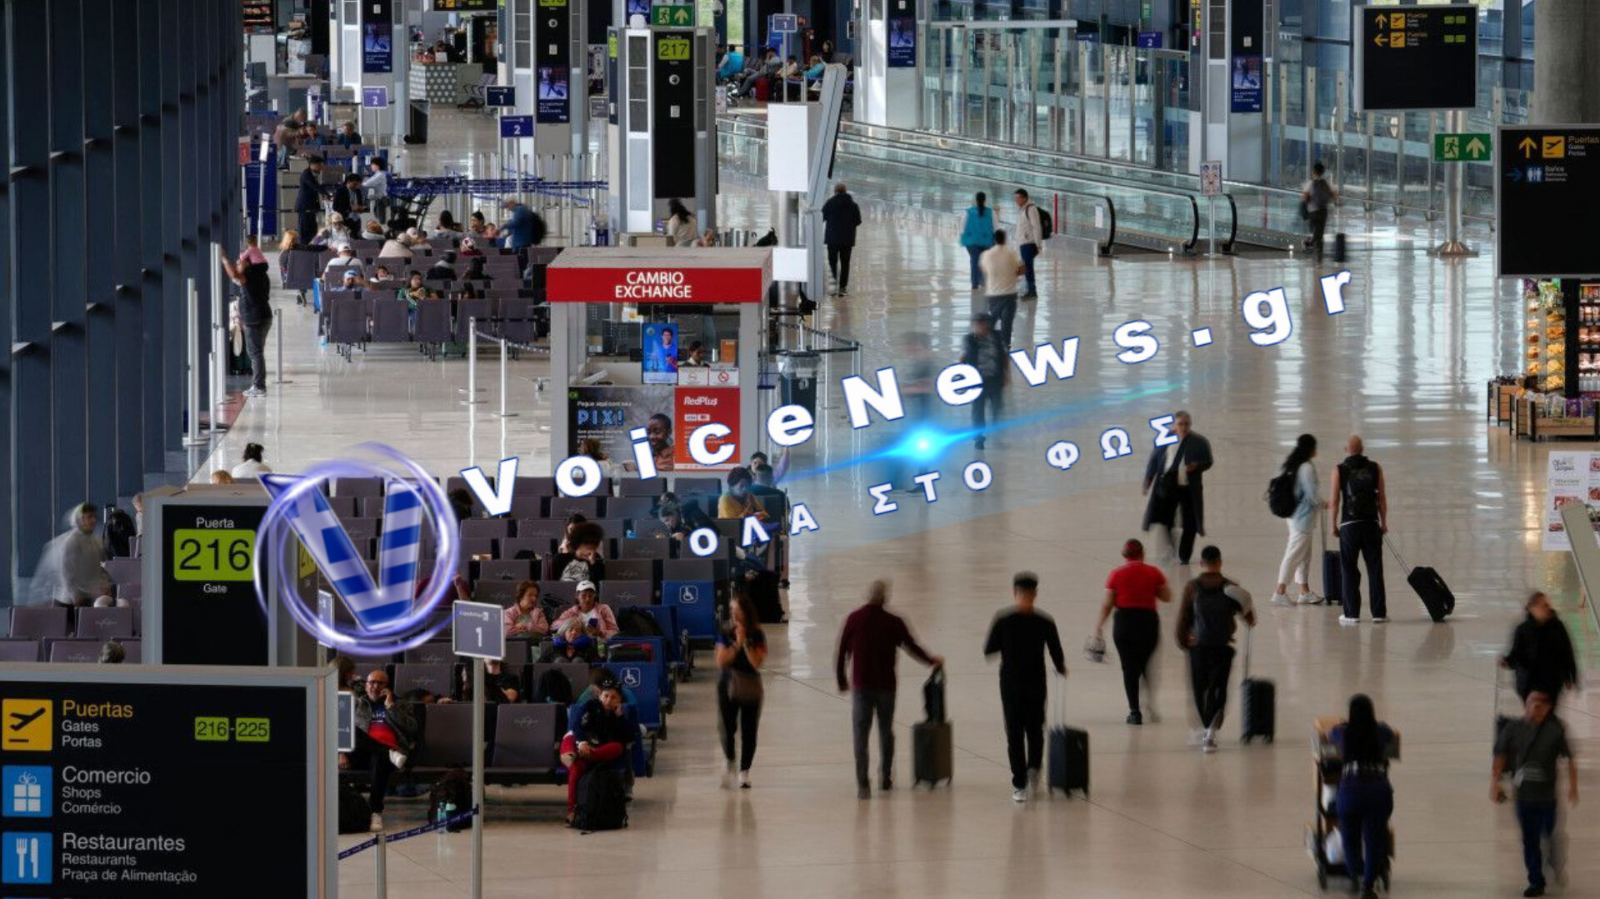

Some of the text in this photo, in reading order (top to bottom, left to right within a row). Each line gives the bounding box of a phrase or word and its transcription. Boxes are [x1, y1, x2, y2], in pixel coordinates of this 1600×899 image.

[660, 43, 688, 57] 217
[513, 124, 521, 135] 2
[626, 271, 684, 284] CAMBIO
[615, 284, 692, 299] EXCHANGE
[577, 409, 624, 425] PIX!
[195, 516, 235, 529] Puerta
[178, 537, 252, 573] 216
[202, 582, 228, 594] Gate
[475, 626, 483, 648] 1
[62, 699, 134, 718] Puertas
[61, 719, 100, 733] Gates
[61, 735, 103, 748] Portas
[61, 766, 151, 785] Comercio
[61, 786, 102, 800] Shops
[61, 801, 122, 815] Comércio
[62, 833, 186, 851] Restaurantes
[61, 853, 137, 866] Restaurants
[61, 868, 198, 884] Praça de Alimentação
